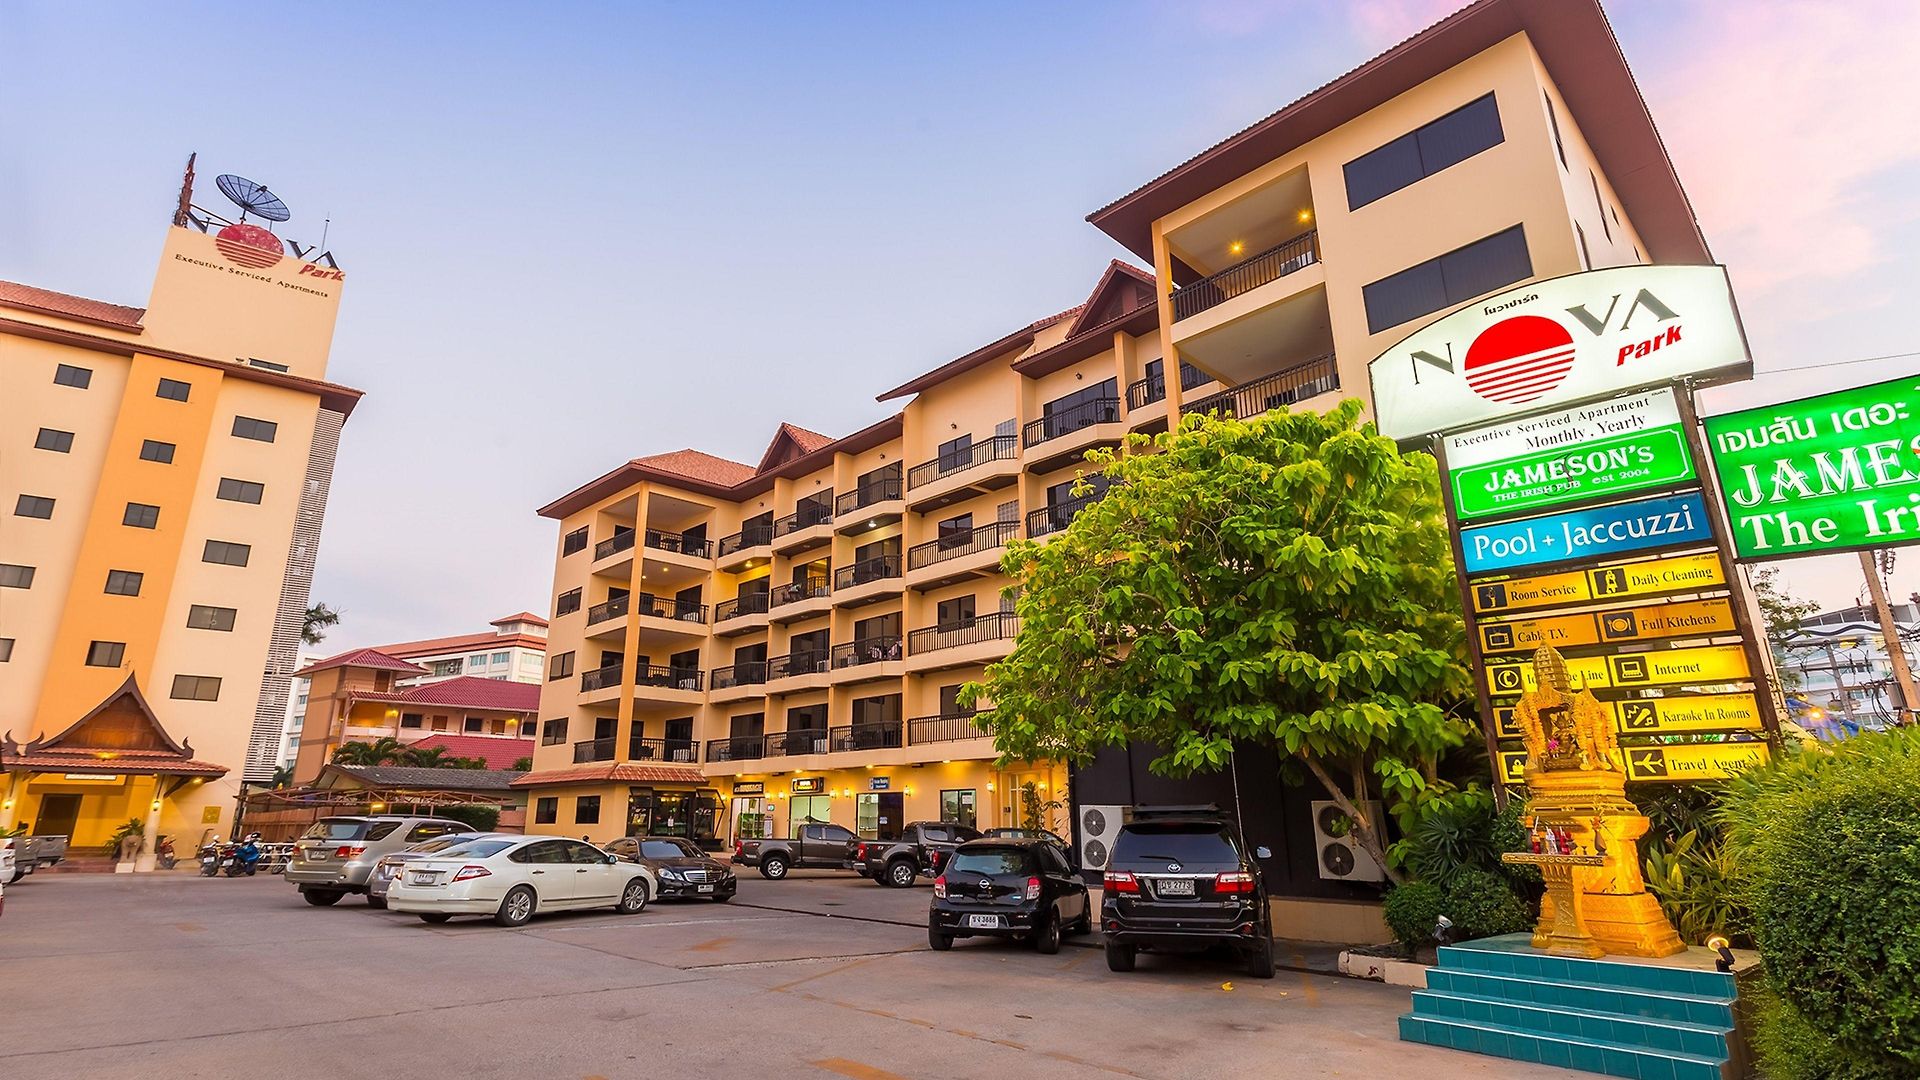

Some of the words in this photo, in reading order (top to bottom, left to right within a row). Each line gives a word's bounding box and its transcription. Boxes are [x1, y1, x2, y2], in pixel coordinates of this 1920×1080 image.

[174, 253, 224, 271] Executive
[228, 267, 272, 283] Serviced
[277, 280, 329, 298] Apartments
[299, 263, 346, 281] Park
[1616, 323, 1683, 367] Park
[1453, 429, 1511, 448] Executive
[1517, 414, 1571, 434] Serviced
[1578, 397, 1650, 422] Apartment
[1526, 426, 1586, 450] Monthly
[1598, 414, 1646, 434] Yearly
[1717, 415, 1818, 454] เจมสัน
[1830, 402, 1910, 434] เดอะ
[1484, 445, 1655, 492] JAMESON'S
[1492, 490, 1520, 502] THE
[1521, 485, 1556, 497] IRISH
[1556, 480, 1582, 492] PUB
[1619, 468, 1651, 480] 2004
[1473, 527, 1537, 560] Pool
[1560, 504, 1695, 556] Jaccuzzi
[1740, 510, 1840, 550] The
[1510, 590, 1539, 601] Room
[1541, 585, 1577, 597] Service
[1631, 573, 1659, 586] Daily
[1662, 568, 1713, 583] Cleaning
[1548, 628, 1568, 639] T.V.
[1641, 618, 1664, 630] Full
[1666, 615, 1717, 628] Kitchens
[1655, 663, 1701, 675] Internet
[1663, 710, 1703, 722] Karaoke
[1704, 709, 1716, 720] In
[1717, 708, 1750, 720] Rooms
[1669, 758, 1708, 771] Travel
